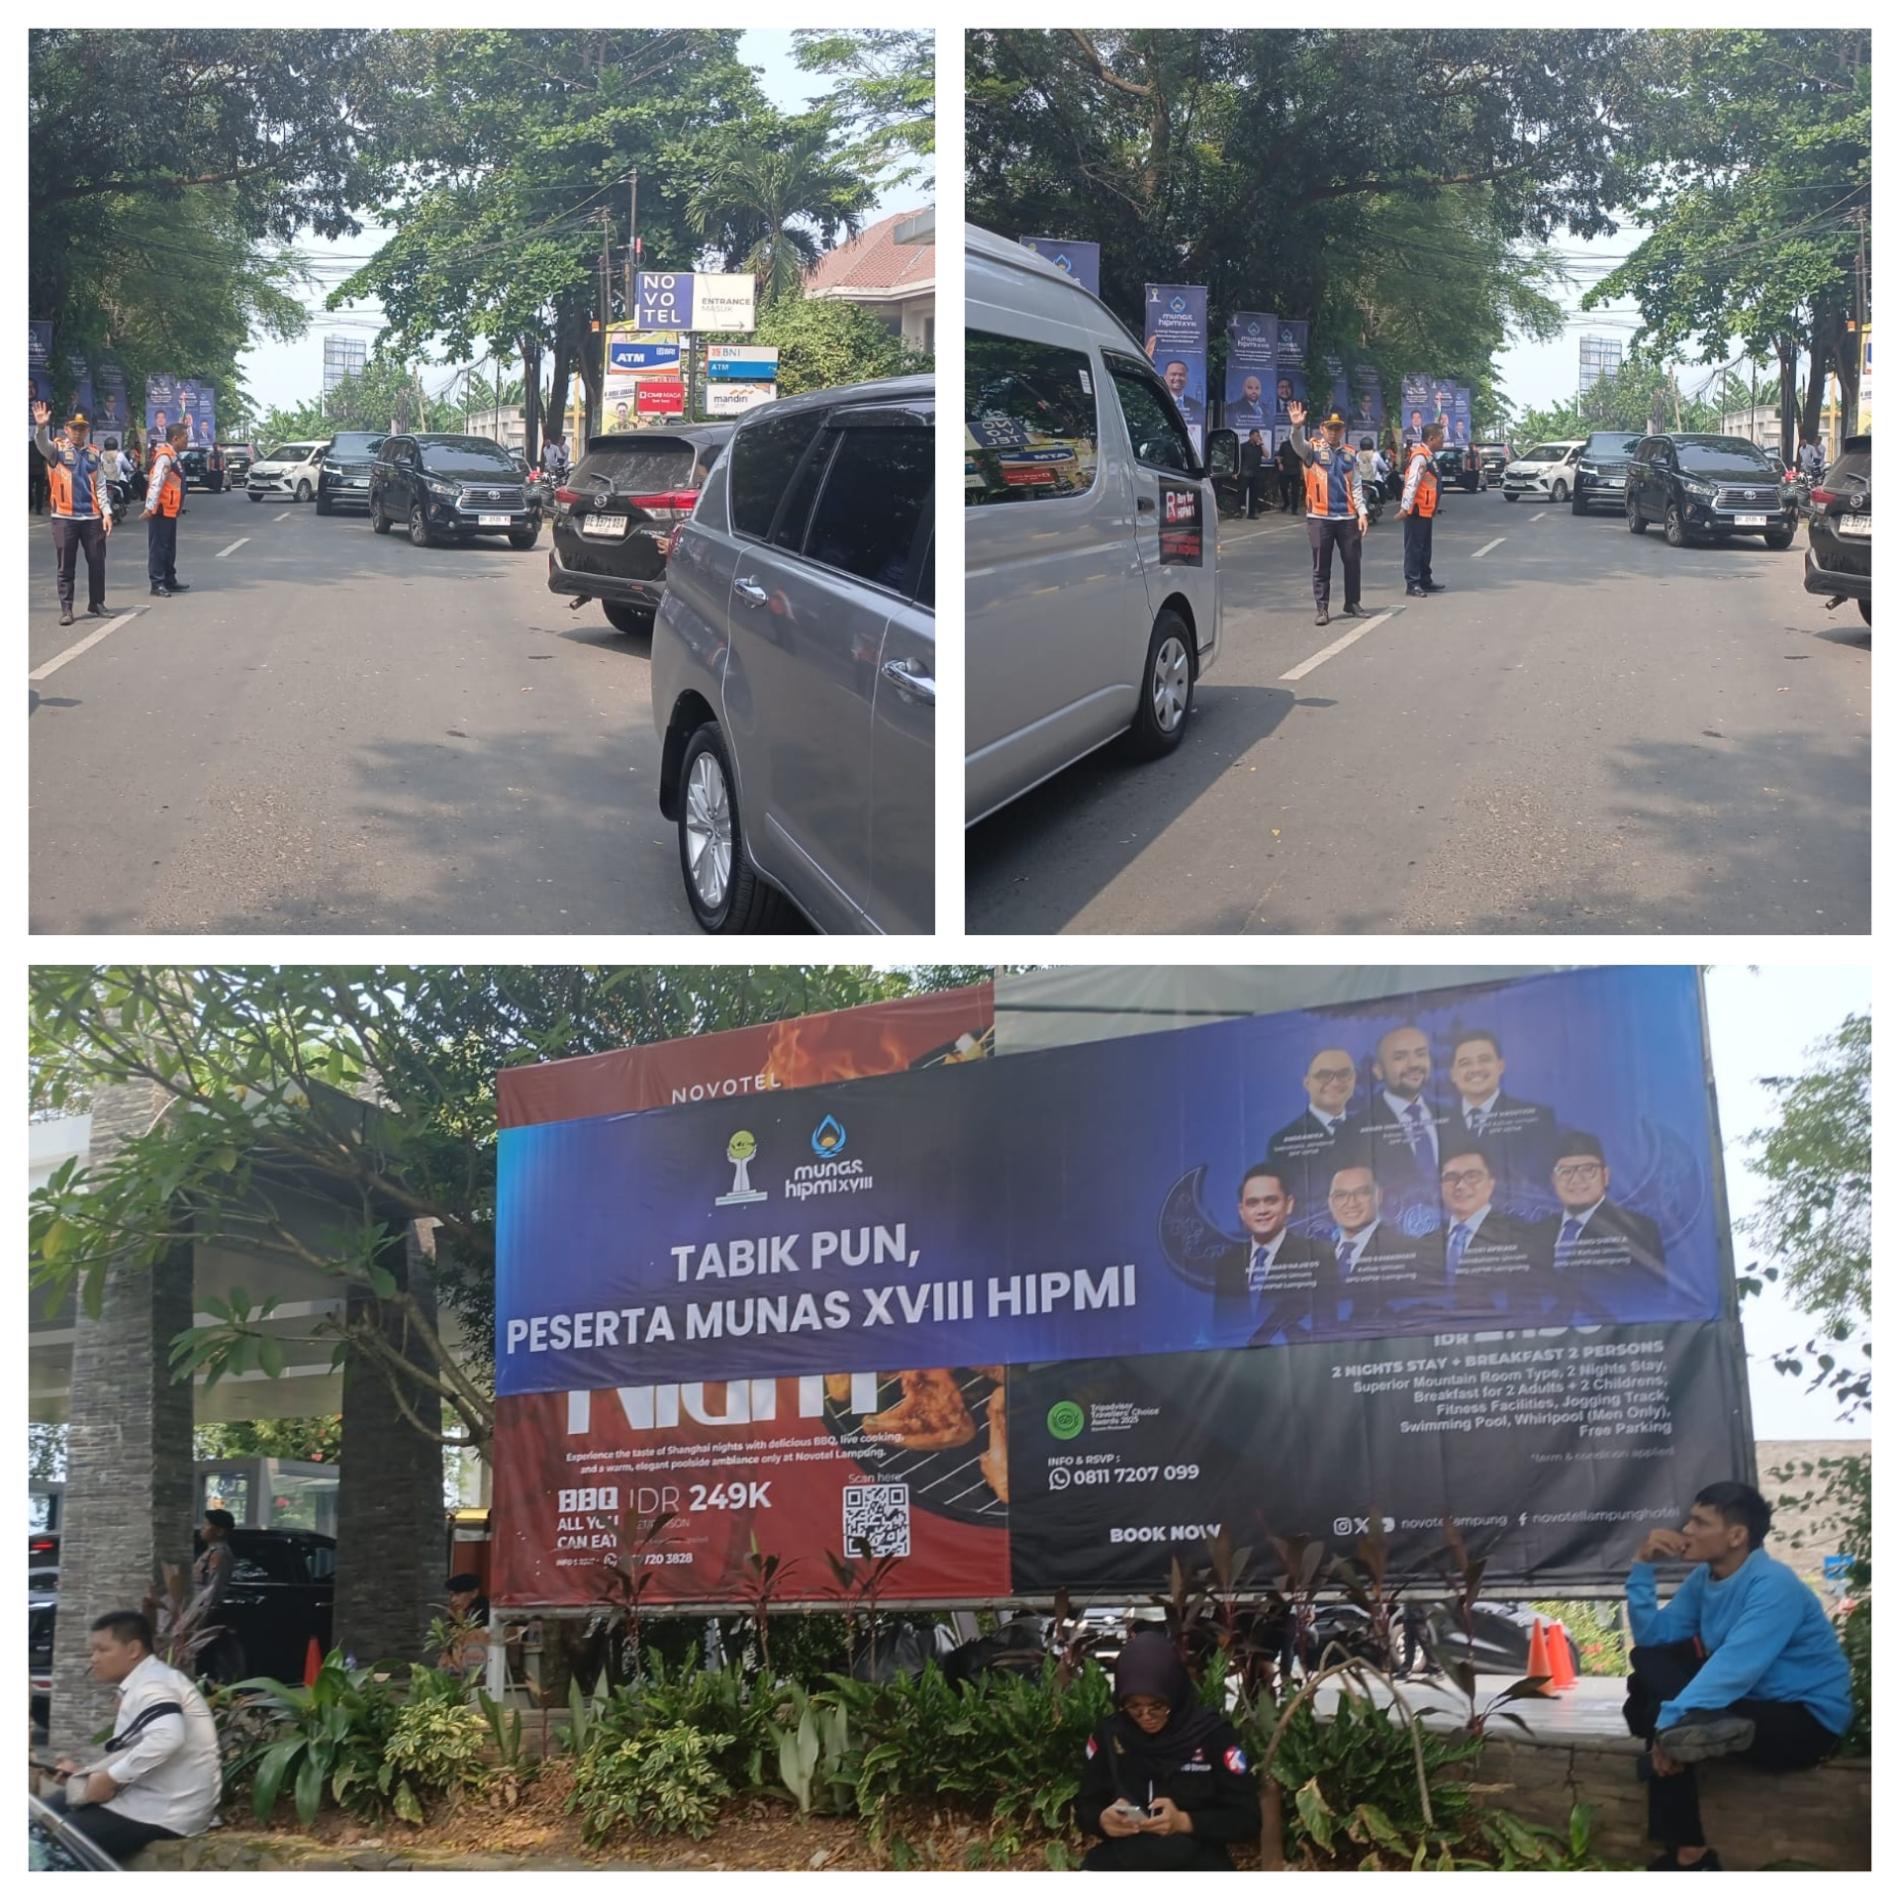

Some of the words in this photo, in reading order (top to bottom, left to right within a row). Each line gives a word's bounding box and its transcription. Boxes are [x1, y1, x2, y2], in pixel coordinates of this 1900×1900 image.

[644, 275, 675, 289] NO
[644, 292, 675, 306] VO
[702, 298, 751, 306] ENTRANCE
[644, 309, 681, 323] TEL
[616, 353, 645, 362] ATM
[722, 348, 740, 356] BNI
[714, 395, 748, 403] mandiri
[671, 1072, 782, 1104] NOVOTEL
[794, 1159, 864, 1181] munas
[670, 1234, 800, 1282] TABIK
[812, 1222, 919, 1268] PUN,
[507, 1305, 674, 1354] PESERTA
[686, 1288, 851, 1340] MUNAS
[862, 1278, 974, 1327] XVIII
[988, 1263, 1136, 1317] HIPMI
[1332, 1366, 1342, 1378] 2
[1345, 1361, 1403, 1378] NIGHTS
[1406, 1358, 1447, 1373] STAY
[1452, 1359, 1461, 1367] +
[1465, 1348, 1564, 1368] BREAKFAST
[1568, 1348, 1579, 1360] 2
[1583, 1341, 1664, 1358] PERSONS
[1353, 1378, 1410, 1394] Superior
[1414, 1373, 1476, 1389] Mountain
[1480, 1369, 1522, 1384] Room
[1525, 1366, 1564, 1383] Type,
[1567, 1366, 1576, 1378] 2
[1579, 1362, 1626, 1378] Nights
[1630, 1359, 1667, 1376] Stay,
[1414, 1386, 1480, 1404] Breakfast
[1482, 1384, 1502, 1398] for
[1506, 1384, 1515, 1396] 2
[1518, 1380, 1564, 1396] Adults
[1580, 1380, 1590, 1392] 2
[1593, 1375, 1668, 1391] Childrens,
[1436, 1401, 1487, 1416] Fitness
[1491, 1396, 1559, 1412] Facilities,
[1562, 1392, 1621, 1411] Jogging
[1626, 1389, 1670, 1404] Track,
[1400, 1418, 1472, 1434] Swimming
[1475, 1414, 1512, 1430] Pool,
[1514, 1410, 1584, 1428] Whirlpool
[1587, 1407, 1624, 1423] (Men
[1580, 1424, 1612, 1438] Free
[1615, 1420, 1672, 1437] Parking
[566, 1450, 614, 1463] Experience
[615, 1449, 631, 1460] the
[632, 1447, 655, 1458] taste
[656, 1446, 666, 1456] of
[667, 1444, 710, 1457] Shanghai
[712, 1440, 744, 1454] nights
[745, 1439, 766, 1451] with
[768, 1437, 812, 1450] delicious
[813, 1436, 838, 1448] BBQ,
[840, 1434, 858, 1445] live
[580, 1464, 598, 1474] and
[606, 1462, 634, 1473] warm,
[636, 1459, 670, 1472] elegant
[671, 1456, 709, 1470] poolside
[710, 1454, 759, 1466] ambiance
[761, 1452, 782, 1465] only
[783, 1452, 794, 1462] at
[795, 1449, 834, 1462] Novotel
[1048, 1456, 1074, 1466] INFO
[1076, 1456, 1084, 1466] &
[1086, 1454, 1114, 1465] RSVP
[848, 1474, 874, 1484] Scan
[1074, 1468, 1110, 1485] 0811
[1114, 1466, 1158, 1483] 7207
[1164, 1464, 1200, 1480] 099
[558, 1486, 618, 1513] BBQ
[630, 1486, 680, 1514] IDR
[689, 1481, 772, 1512] 249K
[558, 1517, 584, 1532] ALL
[558, 1536, 588, 1549] CAN
[1110, 1526, 1166, 1544] BOOK
